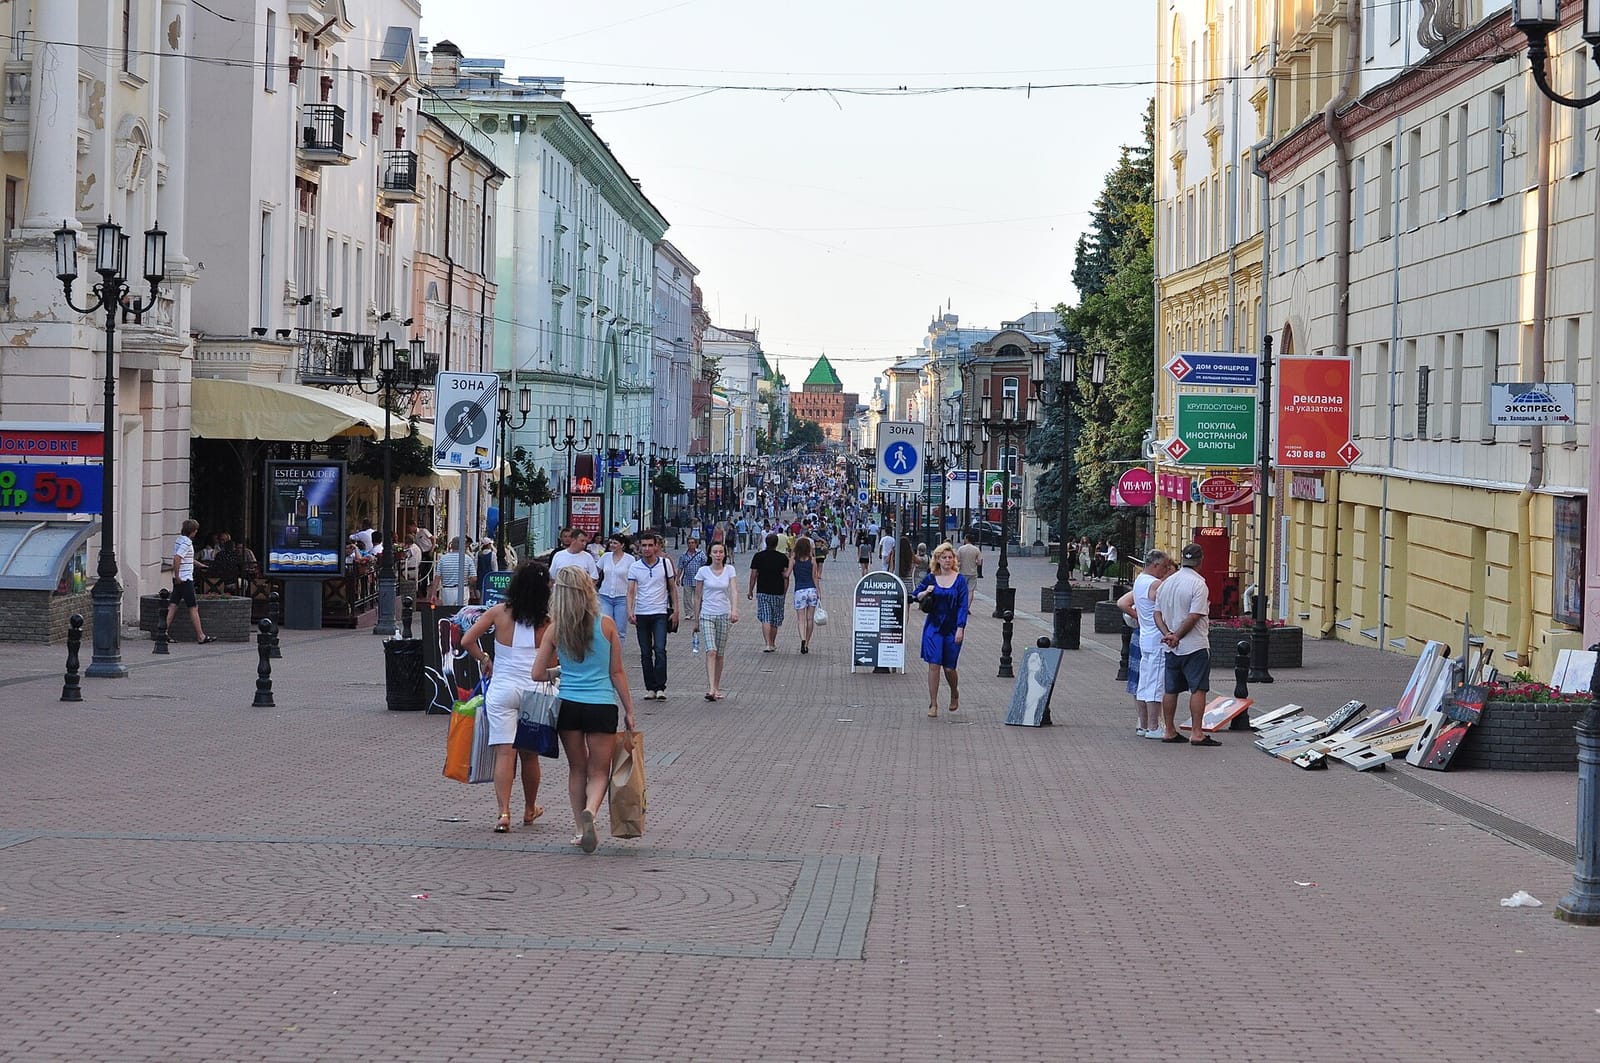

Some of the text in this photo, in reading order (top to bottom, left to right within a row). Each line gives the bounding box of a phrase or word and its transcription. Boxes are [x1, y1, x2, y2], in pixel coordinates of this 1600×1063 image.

[451, 379, 485, 391] ЗОНА
[1293, 395, 1343, 405] реклама
[1186, 403, 1247, 411] КРУГЛОСУТОЧНО
[1296, 405, 1343, 413] указателях
[1505, 405, 1562, 413] ЭКСПРЕСС
[1197, 422, 1236, 430] ПОКУПКА
[889, 426, 915, 435] ЗОНА
[1185, 431, 1248, 440] ИНОСТРАННОЙ
[1285, 450, 1326, 458] 430 88 88
[301, 470, 336, 478] LAUDER
[33, 471, 82, 509] 5D
[863, 579, 897, 589] ЛАНЖЭРИ
